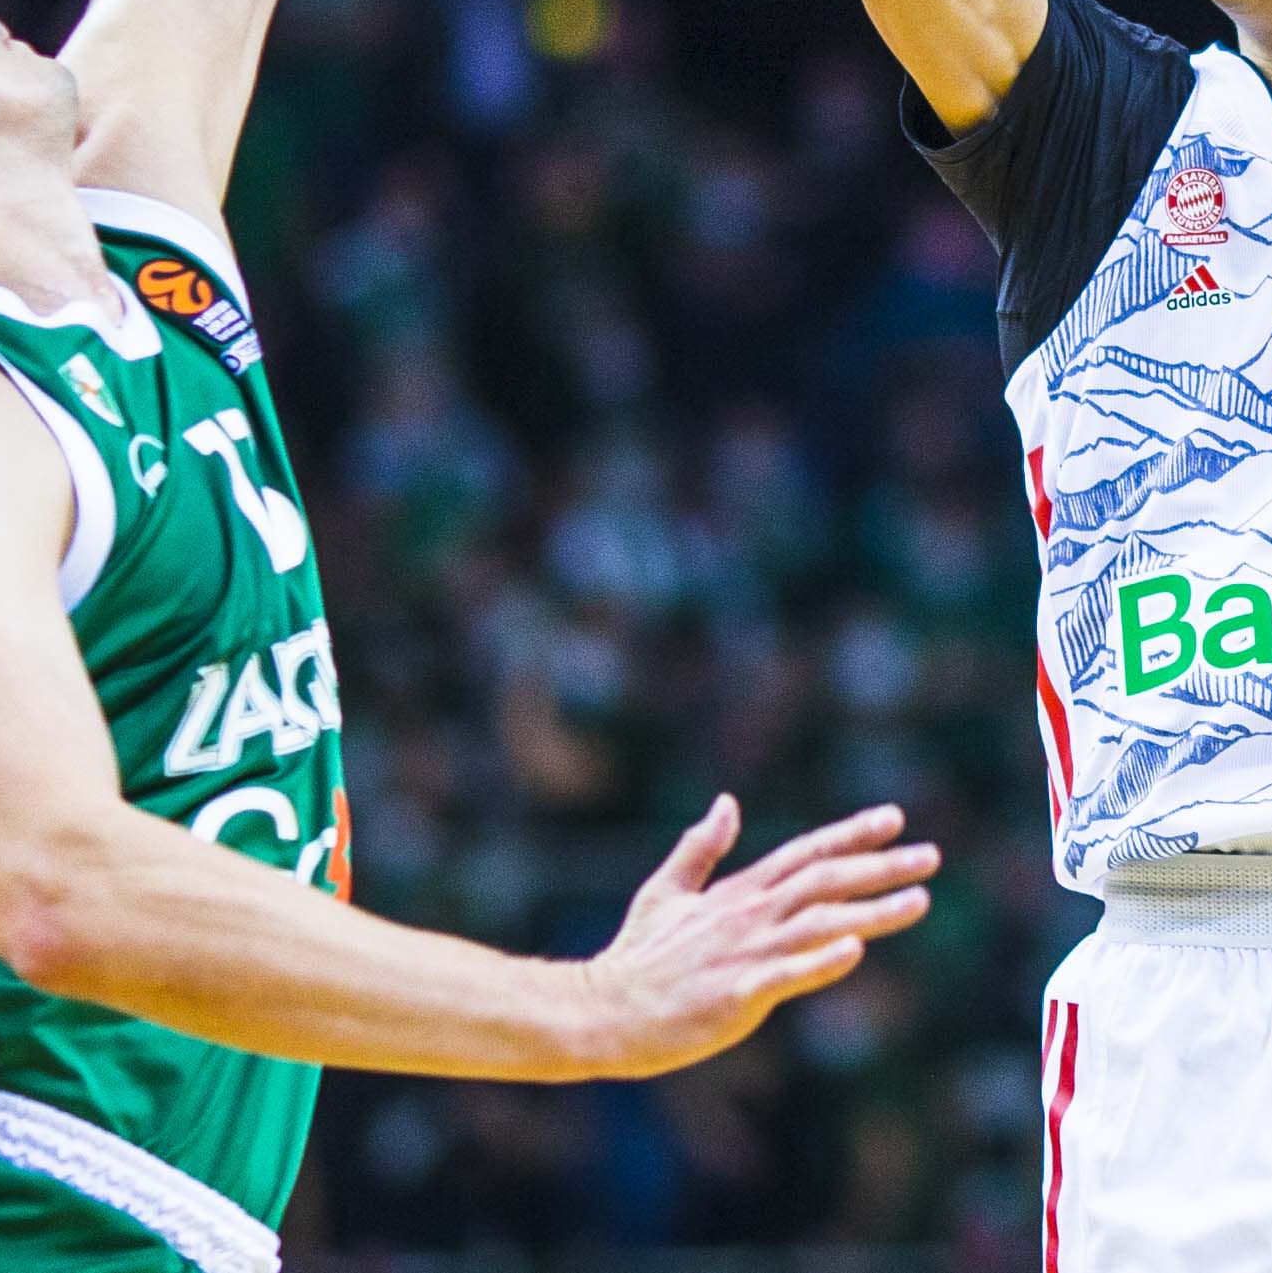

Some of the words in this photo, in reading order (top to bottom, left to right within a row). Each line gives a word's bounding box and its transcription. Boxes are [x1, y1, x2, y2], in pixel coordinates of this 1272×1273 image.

[1182, 171, 1222, 194] BAYERN
[1166, 233, 1226, 244] BASKETBALL
[1166, 291, 1232, 311] adidas
